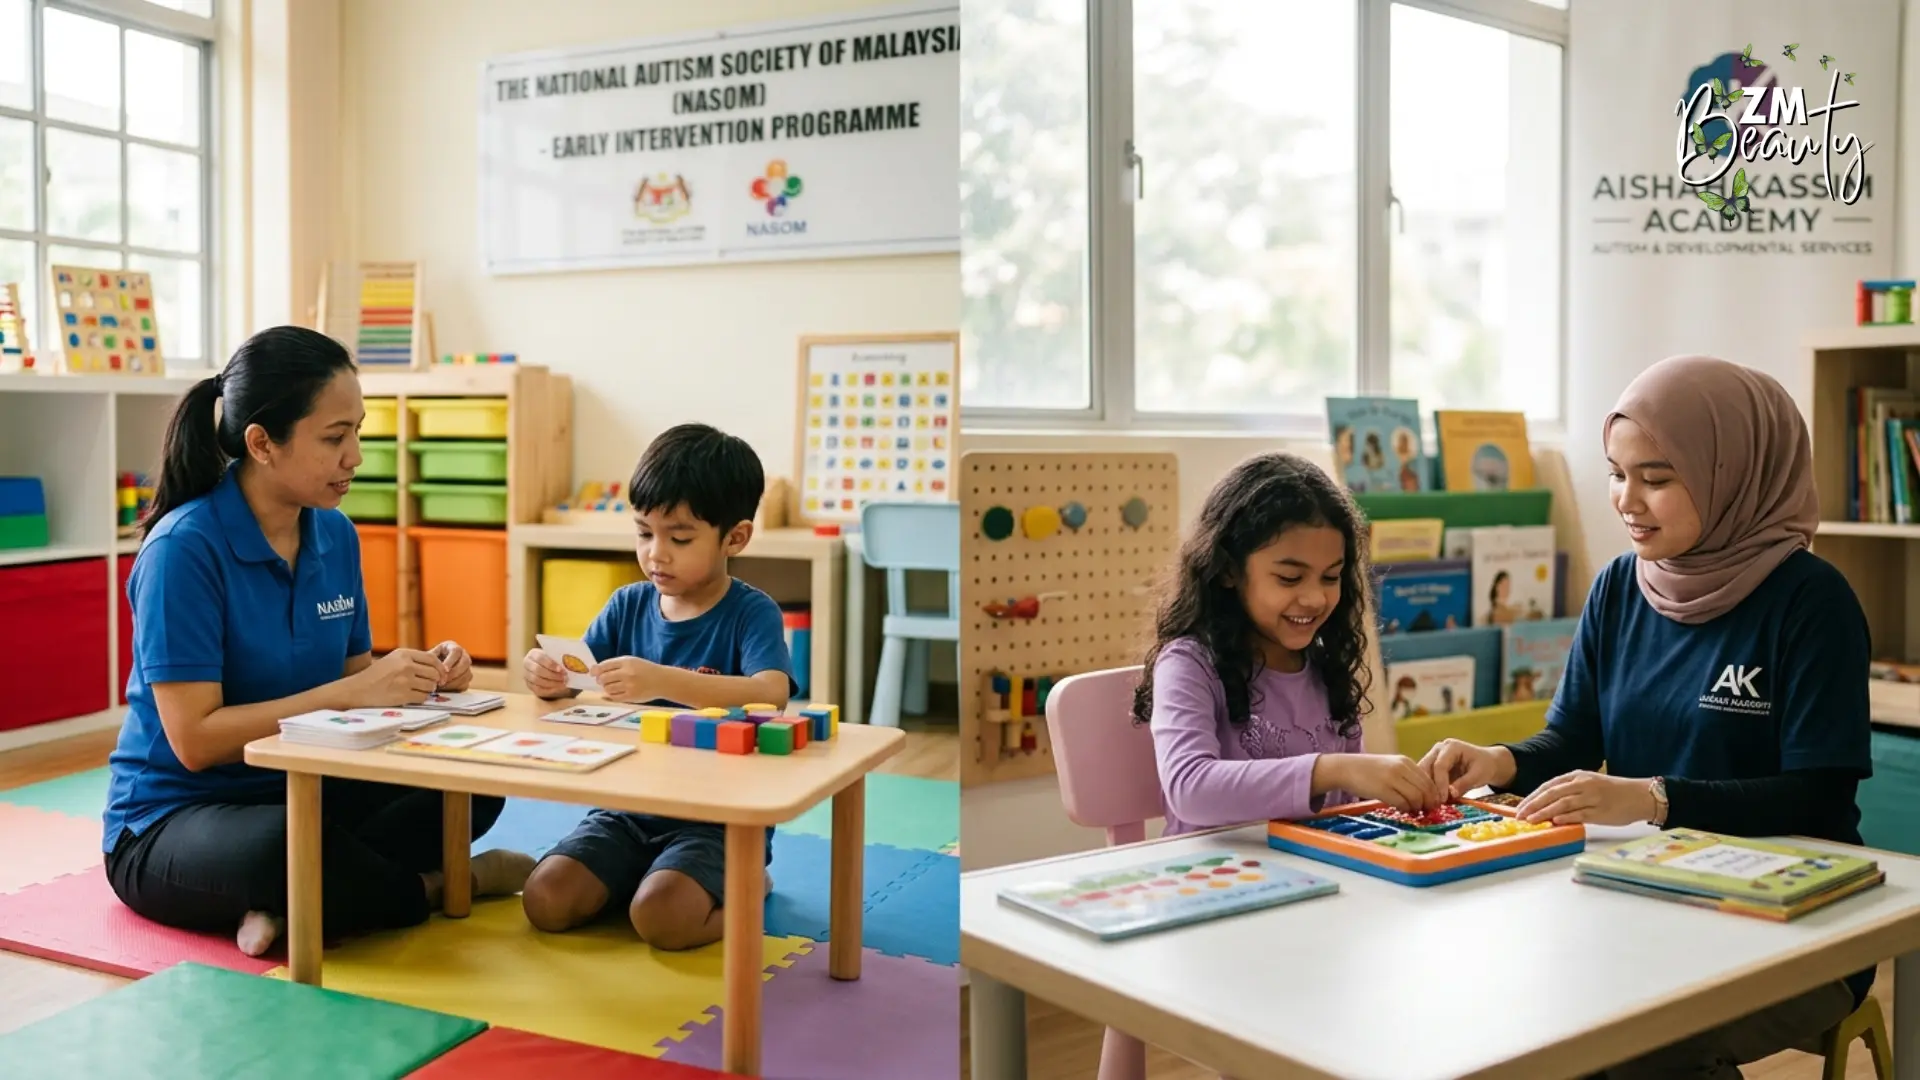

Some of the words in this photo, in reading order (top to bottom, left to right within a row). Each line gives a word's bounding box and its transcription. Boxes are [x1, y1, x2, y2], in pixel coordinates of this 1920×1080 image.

[496, 77, 529, 101] THE
[536, 65, 628, 97] NATIONAL
[634, 55, 715, 86] AUTISM
[720, 44, 813, 76] SOCIETY
[818, 38, 847, 66] OF
[672, 83, 767, 116] (NASOM)
[552, 131, 610, 159] EARLY
[615, 119, 765, 153] INTERVENTION
[771, 102, 922, 140] PROGRAMME
[746, 219, 808, 238] NASOM
[1643, 208, 1822, 233] ACADEMY
[1652, 243, 1661, 255] &
[1668, 242, 1796, 255] DEVELOPMENTAL
[1801, 241, 1873, 255] SERVICES
[1710, 664, 1763, 698] AK
